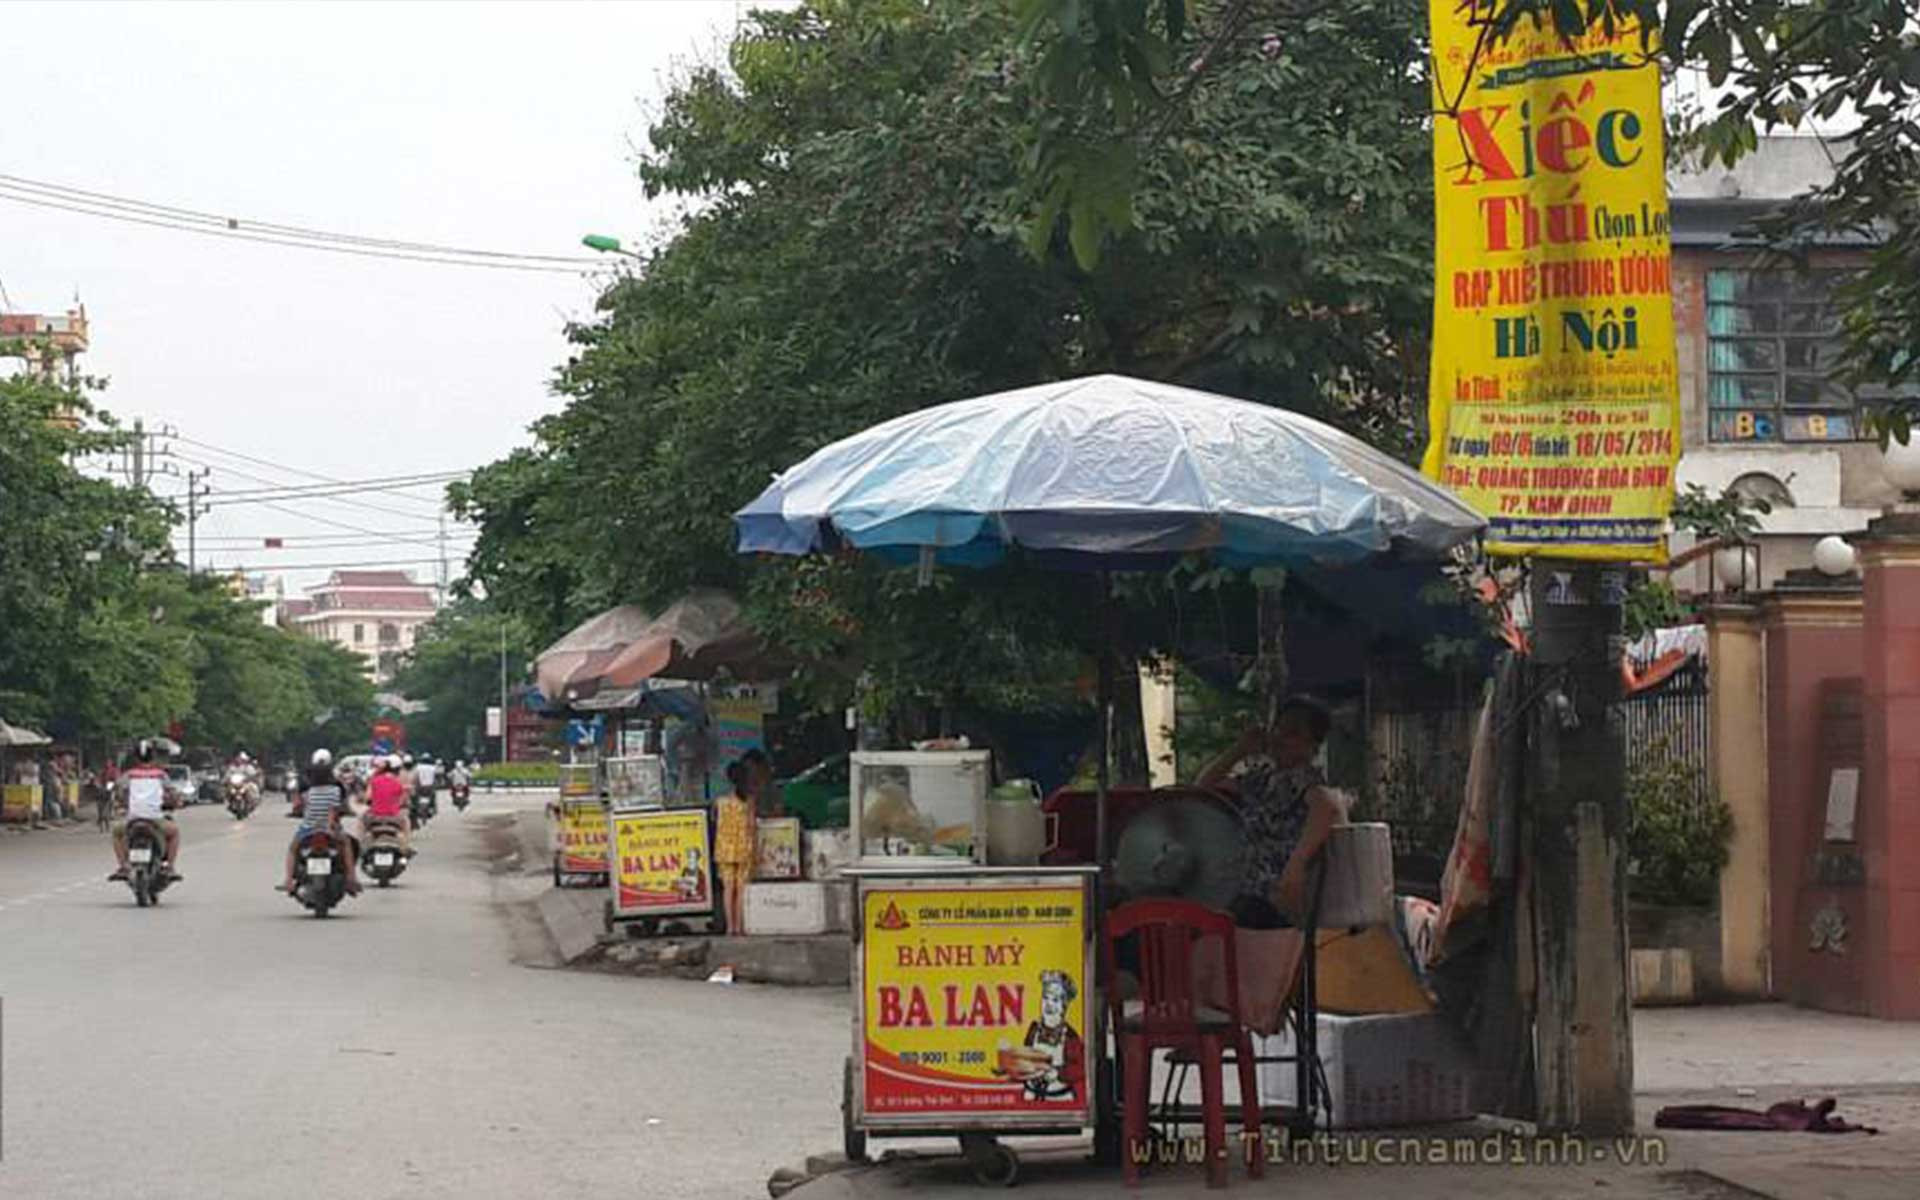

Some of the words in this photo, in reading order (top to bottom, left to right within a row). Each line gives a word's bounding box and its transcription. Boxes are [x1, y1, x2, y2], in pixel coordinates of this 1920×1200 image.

[1453, 79, 1643, 186] Xiếc
[1479, 183, 1589, 252] Thú
[1594, 203, 1637, 249] Chọn
[1454, 270, 1492, 316] RẠP
[1540, 257, 1616, 299] TRUNG
[1494, 311, 1541, 359] Hà
[1560, 305, 1638, 359] Nội
[1477, 461, 1530, 490] QUẢNG
[1527, 494, 1563, 514] NAM
[878, 985, 933, 1028] BA
[943, 984, 1026, 1028] LAN
